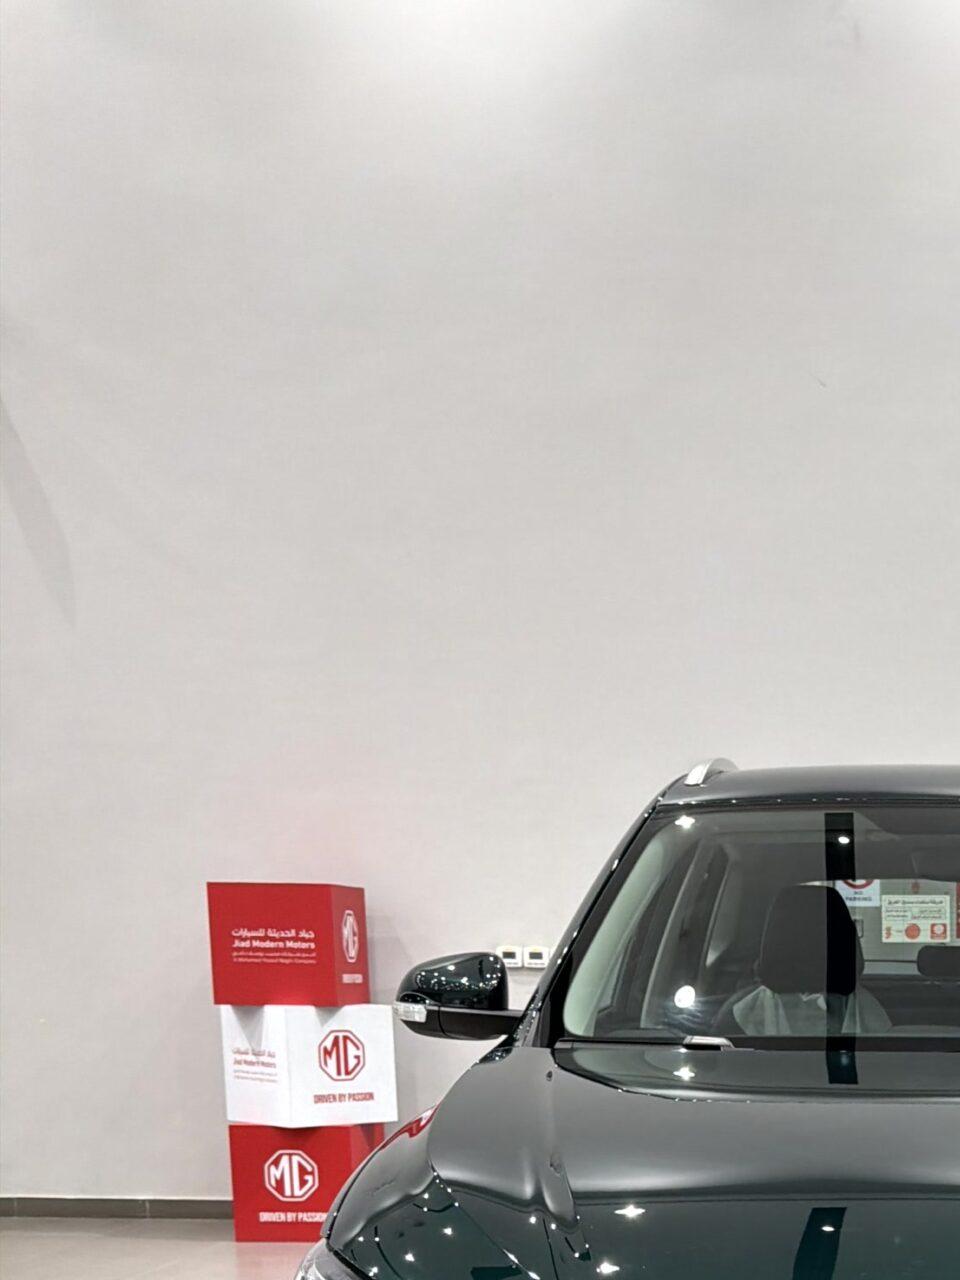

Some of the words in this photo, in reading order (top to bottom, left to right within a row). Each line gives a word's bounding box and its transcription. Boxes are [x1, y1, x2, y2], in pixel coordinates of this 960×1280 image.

[232, 939, 251, 948] Jiad
[252, 940, 285, 949] Modern
[286, 941, 316, 950] Motors
[322, 1033, 362, 1077] MG
[313, 1093, 337, 1104] DRIVEN
[338, 1093, 346, 1102] BY
[347, 1092, 374, 1102] PASSION
[268, 1153, 315, 1198] MG
[287, 1211, 297, 1222] BY
